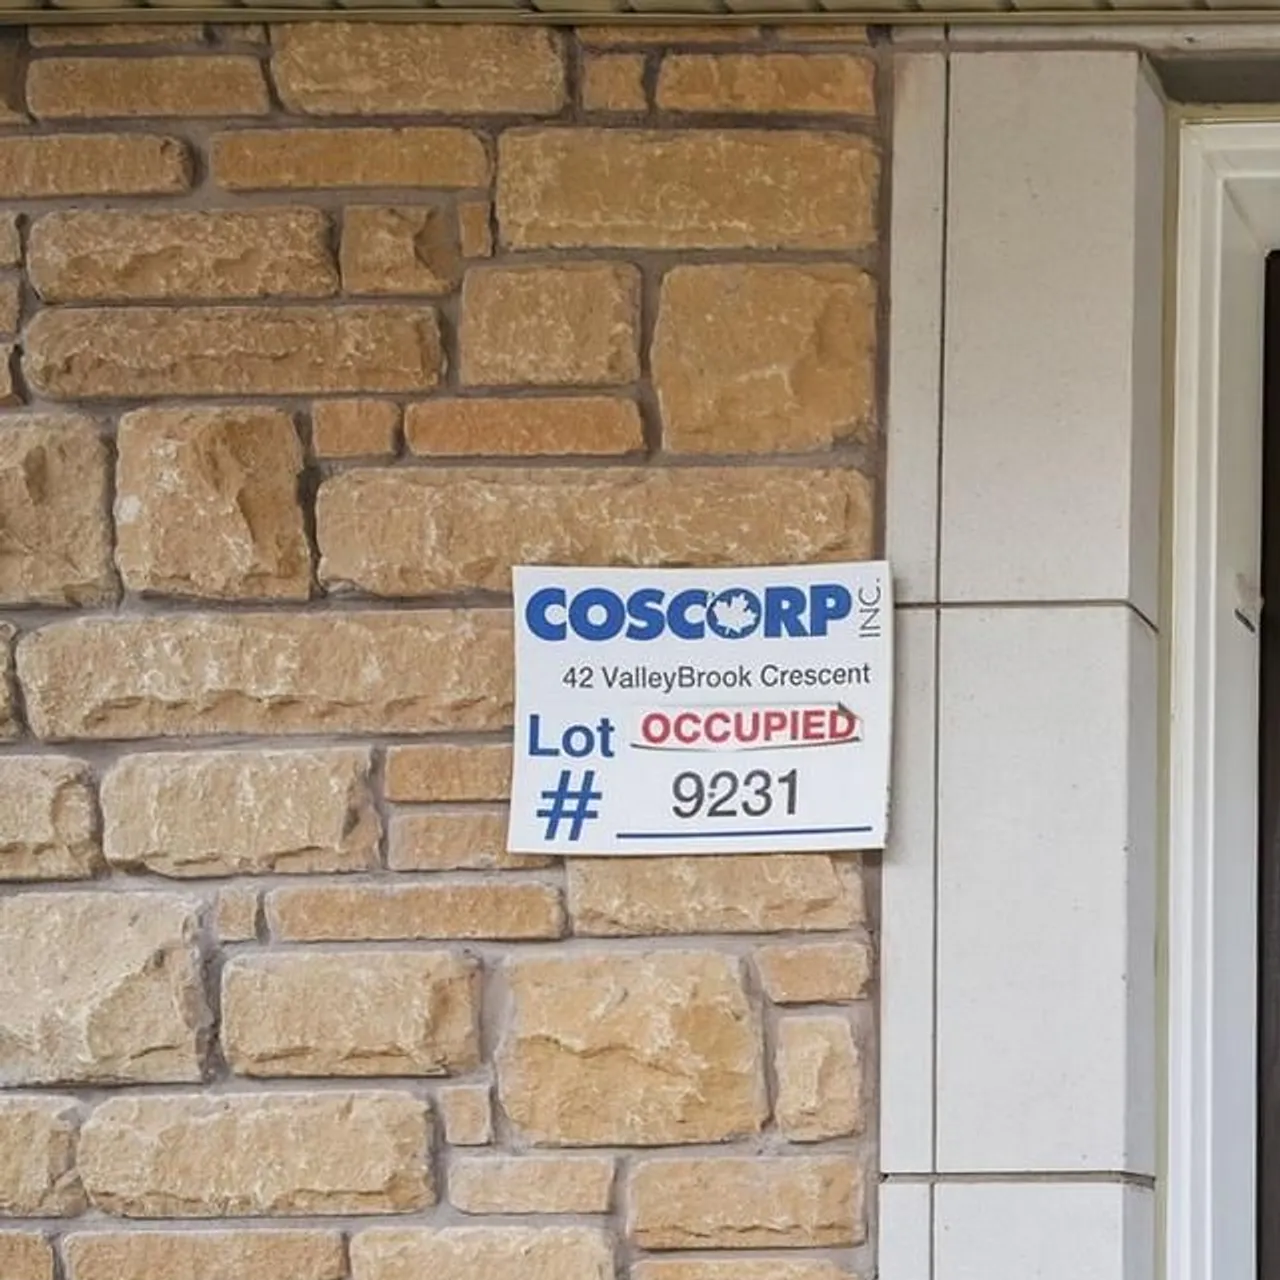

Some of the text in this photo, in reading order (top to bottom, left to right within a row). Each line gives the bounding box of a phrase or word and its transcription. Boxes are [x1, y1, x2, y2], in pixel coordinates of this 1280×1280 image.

[525, 584, 853, 642] COSCORP
[859, 577, 882, 639] INC.
[562, 663, 872, 694] 42 ValleyBrook Crescent
[528, 709, 857, 758] Lot OCCUPIED
[536, 768, 801, 842] # 9231
